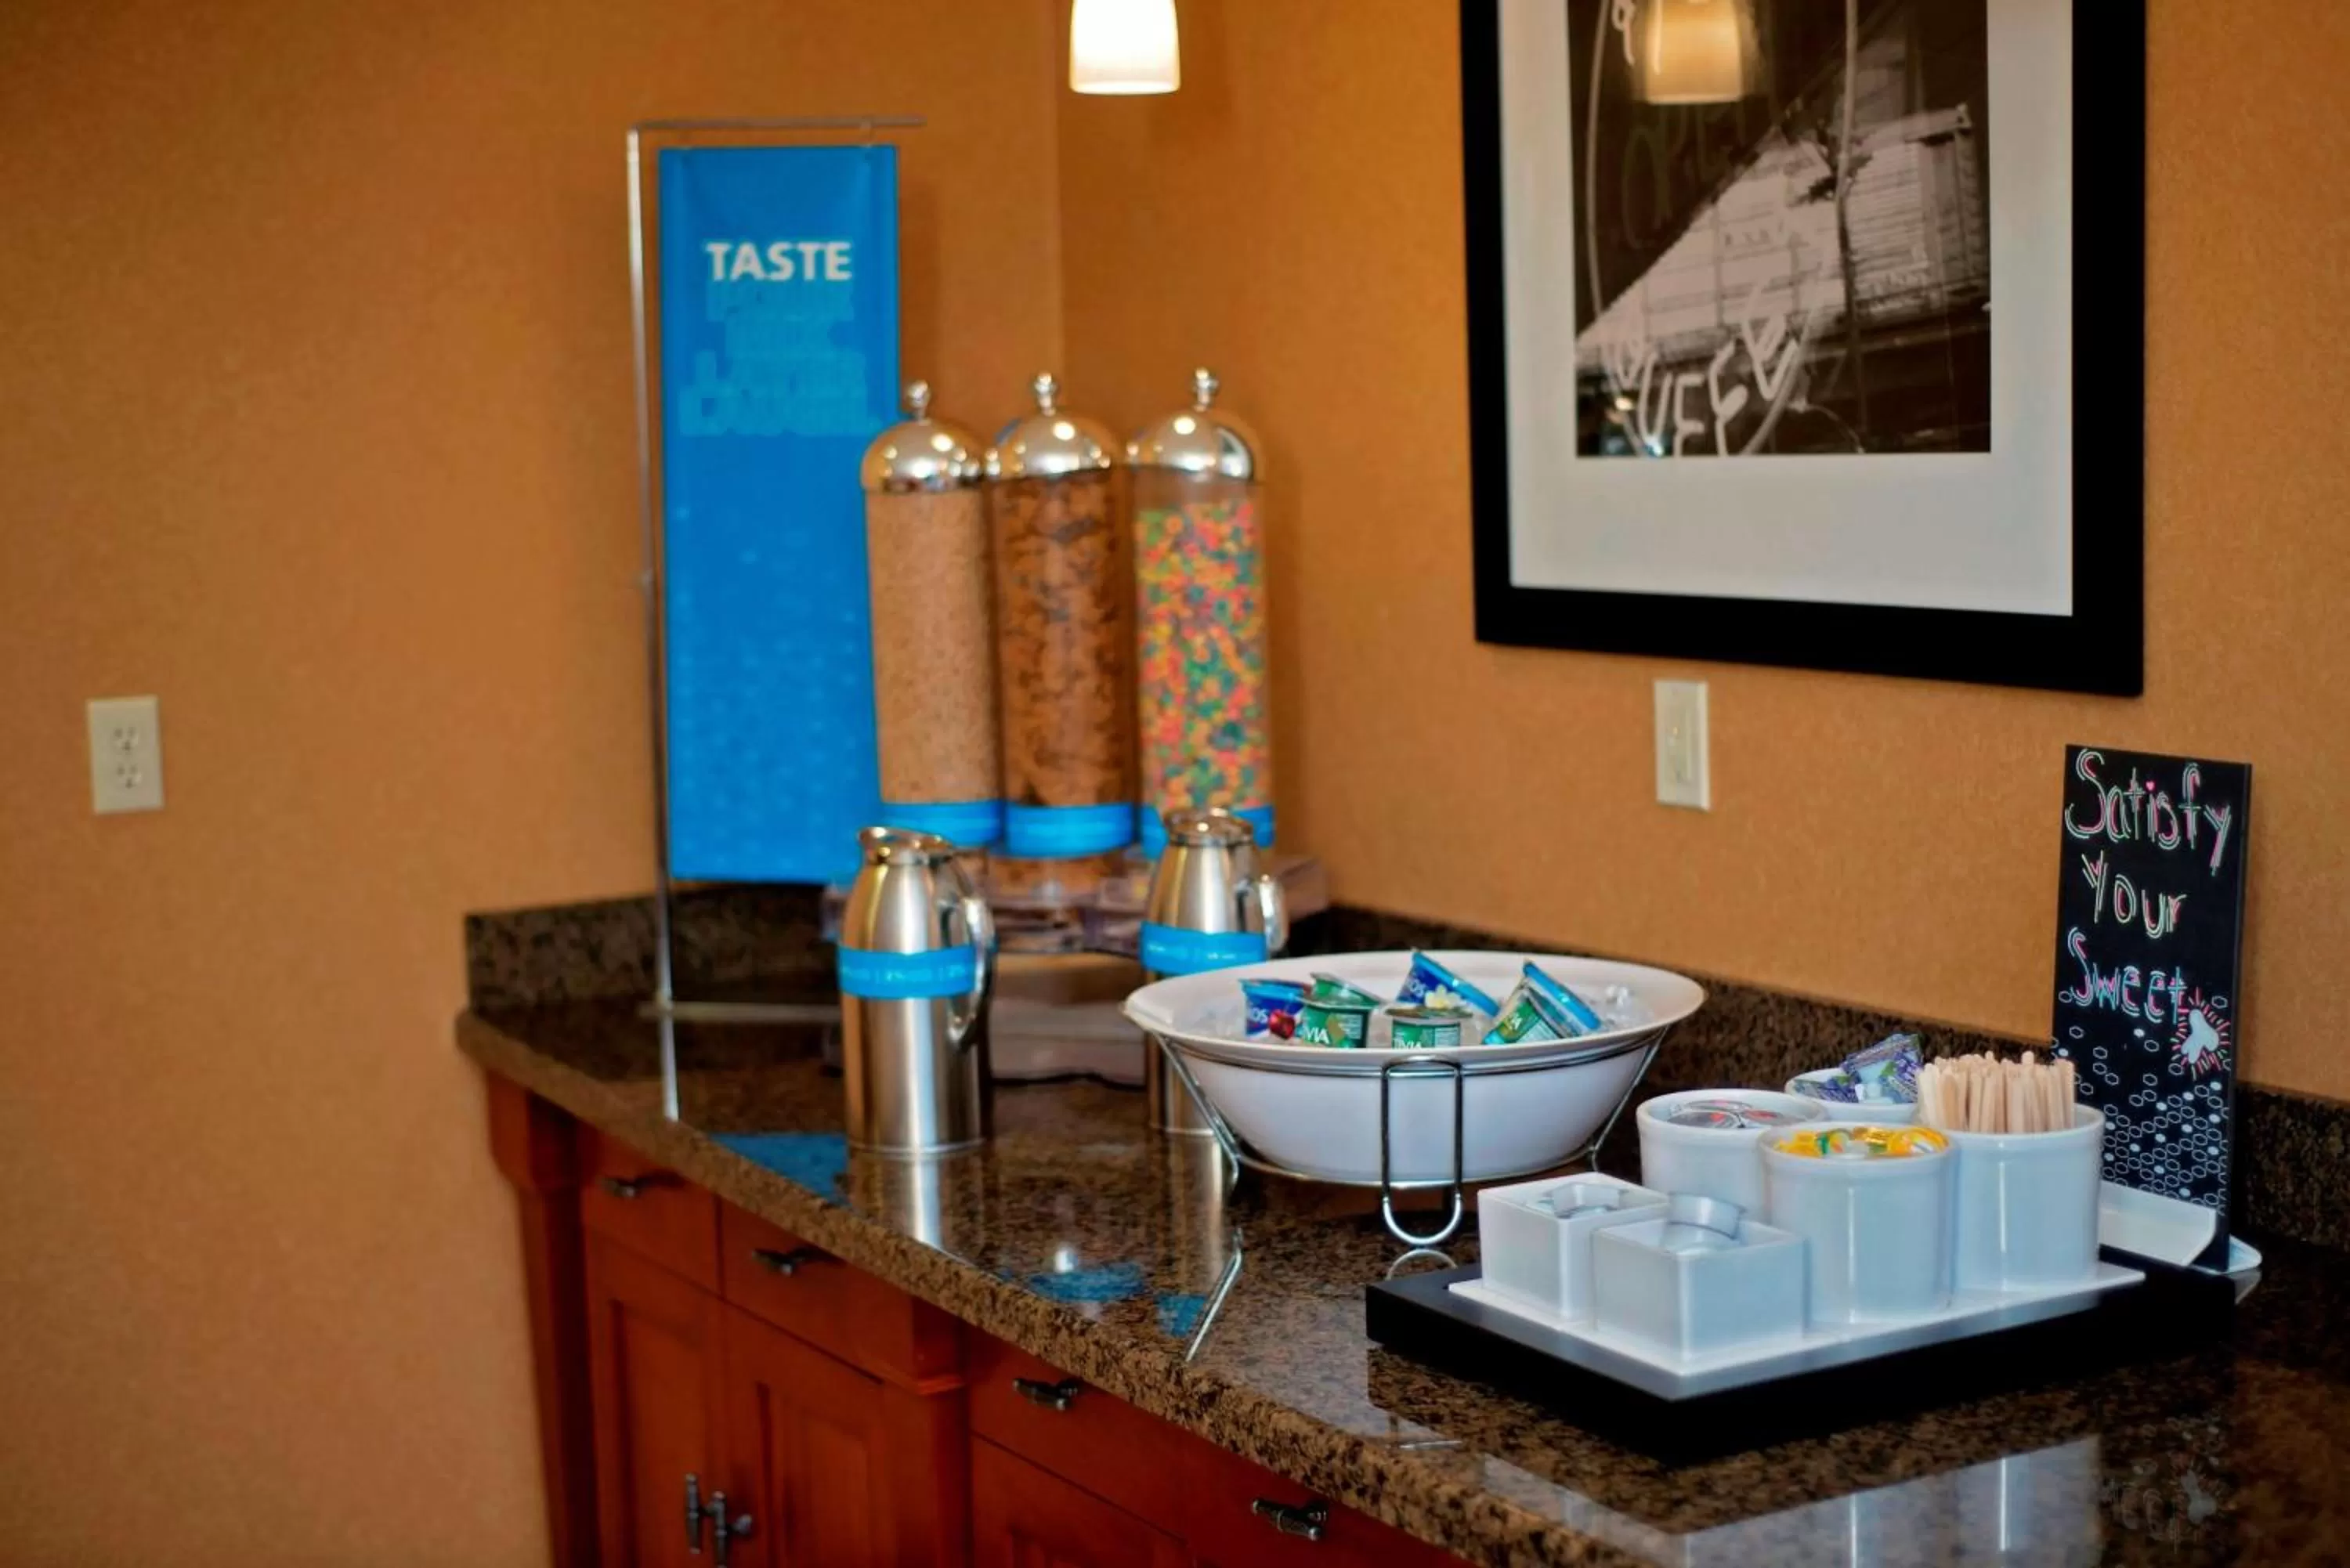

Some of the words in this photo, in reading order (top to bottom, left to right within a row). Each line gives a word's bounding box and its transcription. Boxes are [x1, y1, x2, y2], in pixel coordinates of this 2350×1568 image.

[706, 240, 854, 282] TASTE
[2064, 748, 2232, 877] Satisfy
[2066, 927, 2188, 1025] Sweet
